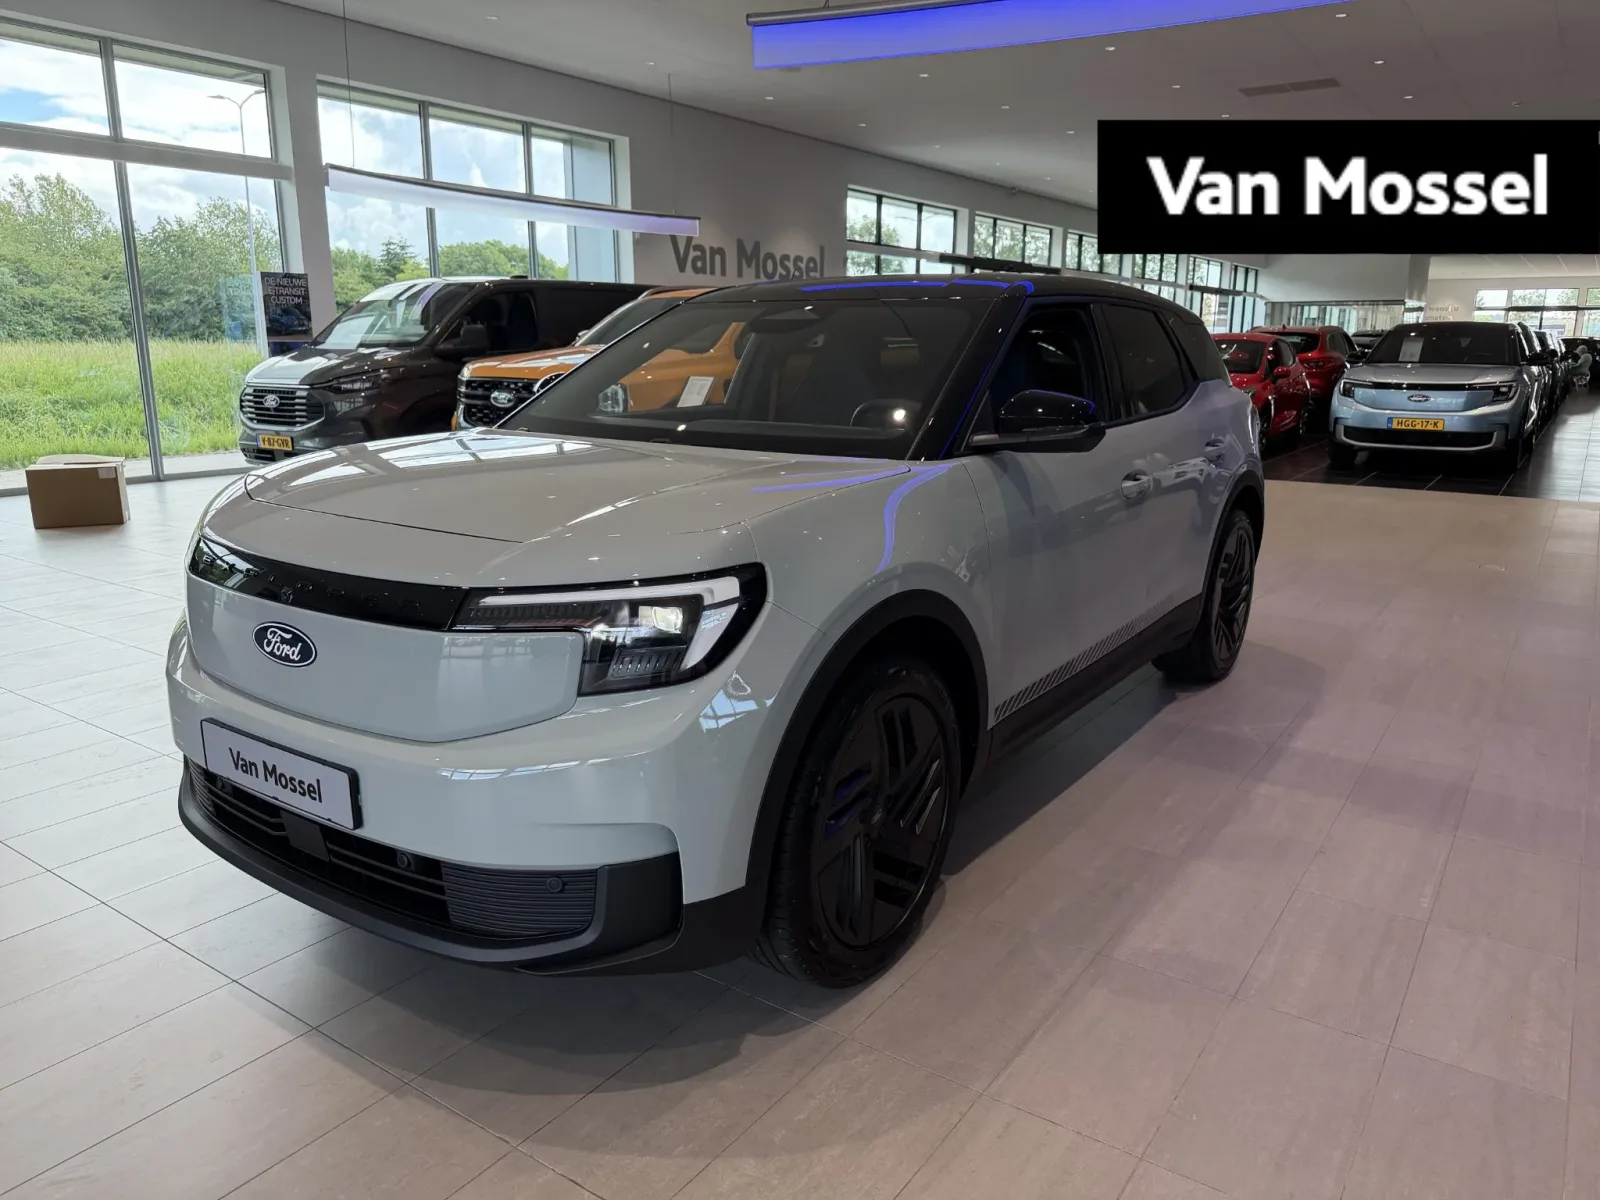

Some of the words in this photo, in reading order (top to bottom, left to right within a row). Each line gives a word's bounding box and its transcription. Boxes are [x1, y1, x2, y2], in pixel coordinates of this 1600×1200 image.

[669, 234, 727, 277] Van
[736, 238, 825, 280] Mossel
[264, 277, 276, 286] DE
[277, 277, 307, 287] NIEUWE
[271, 296, 303, 305] CUSTOM
[1396, 419, 1440, 429] HGG-17-K
[263, 627, 302, 661] Ford
[229, 747, 259, 778] Van
[262, 760, 323, 803] Mossel
